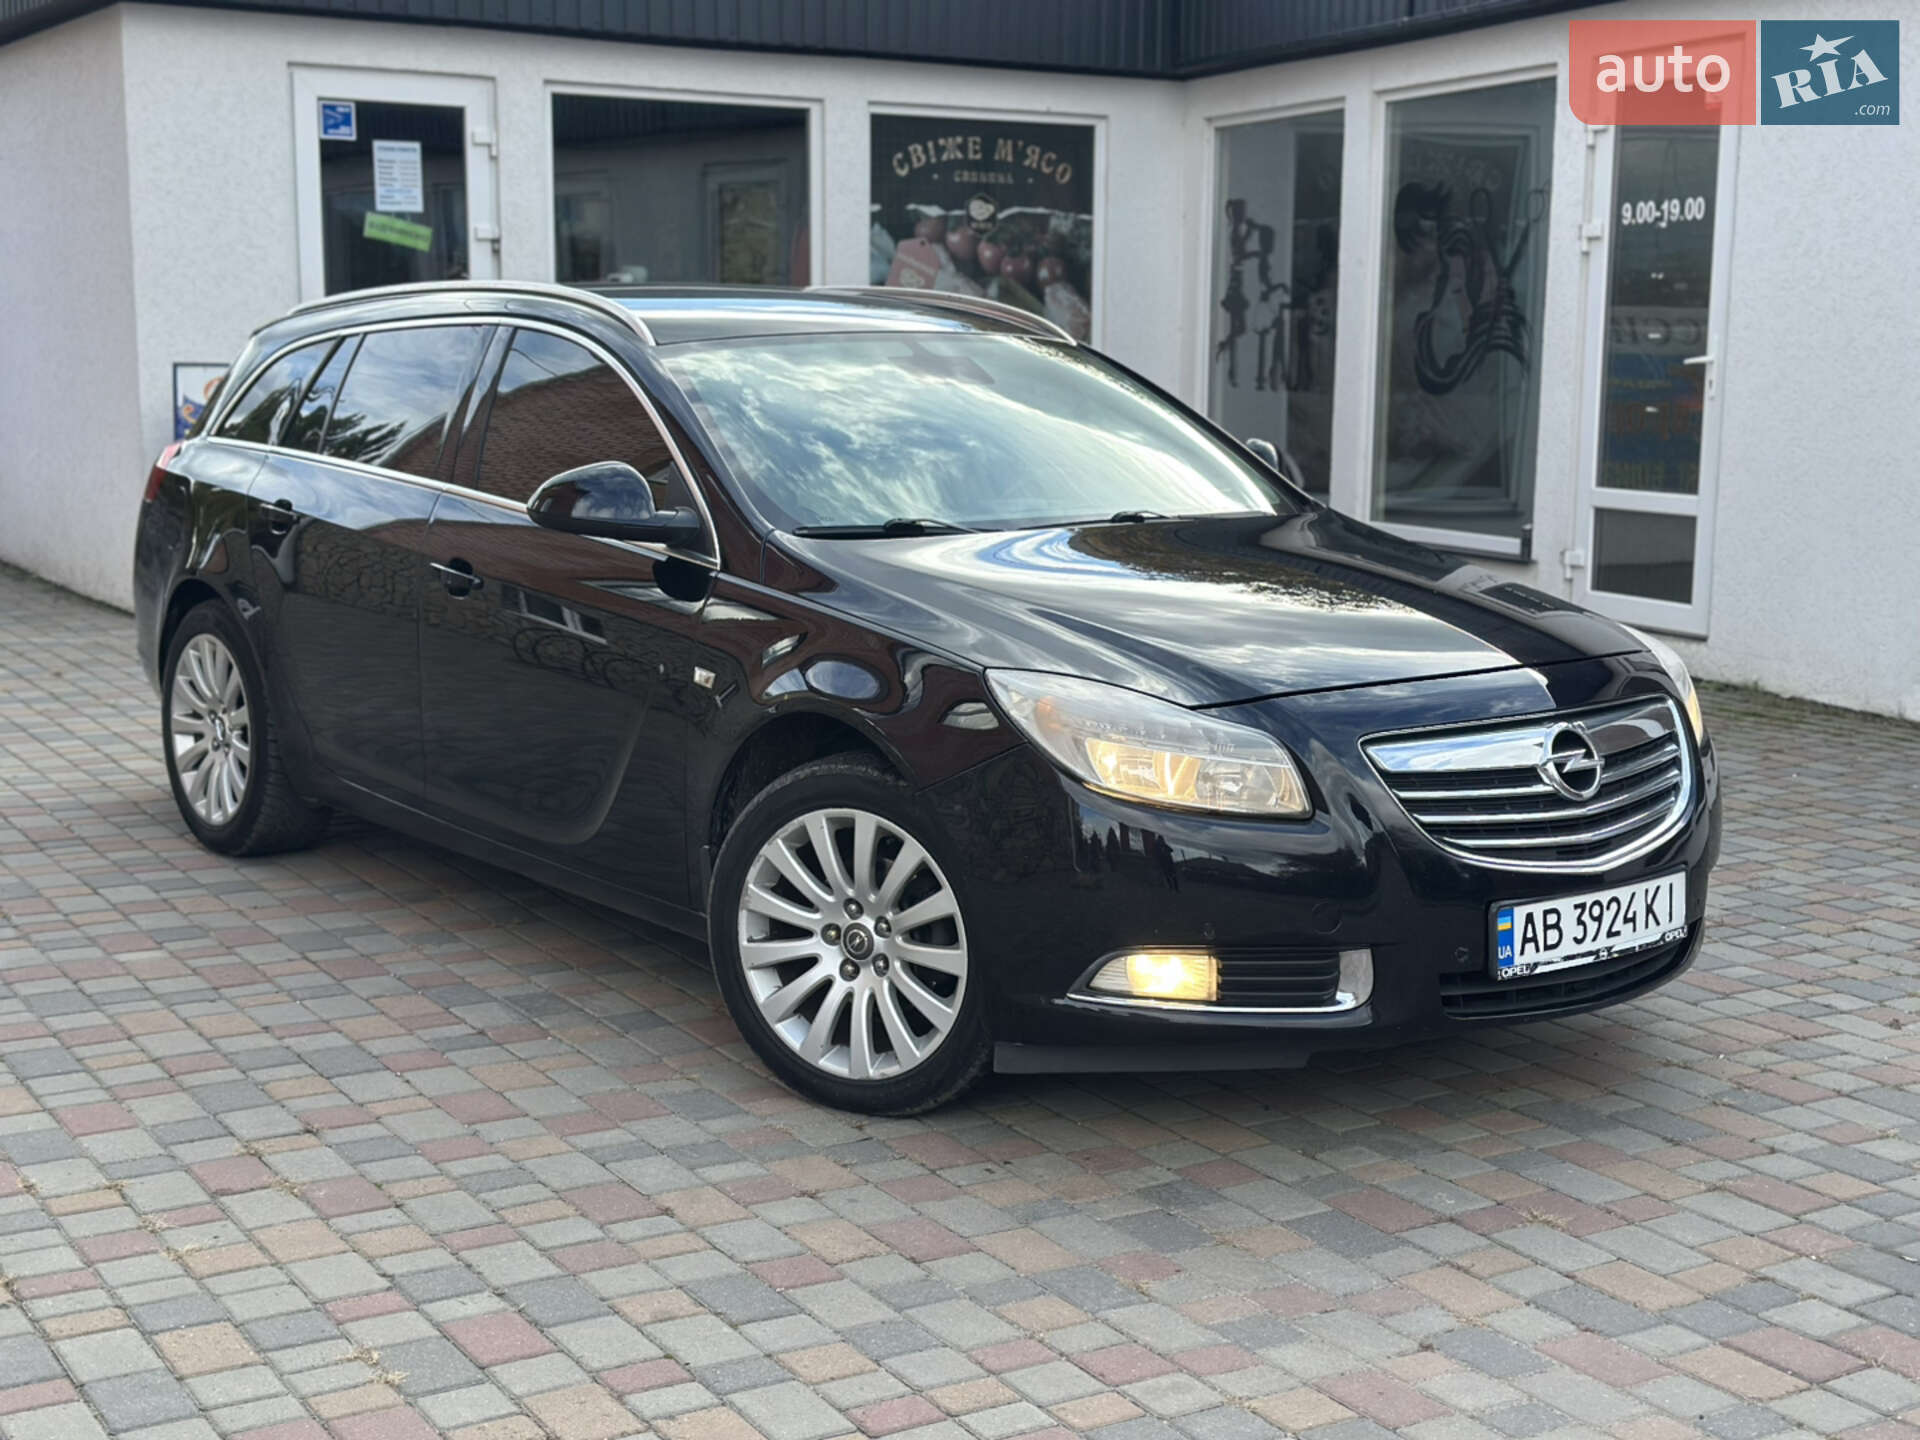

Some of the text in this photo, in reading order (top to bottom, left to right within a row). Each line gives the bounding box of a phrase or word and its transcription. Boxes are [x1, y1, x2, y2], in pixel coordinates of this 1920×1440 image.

[892, 135, 1072, 185] СВІЖЕ М'ЯСО
[1621, 196, 1706, 229] 9.00-19.00
[1519, 882, 1674, 957] AB 3924 KI
[1498, 945, 1512, 960] UA
